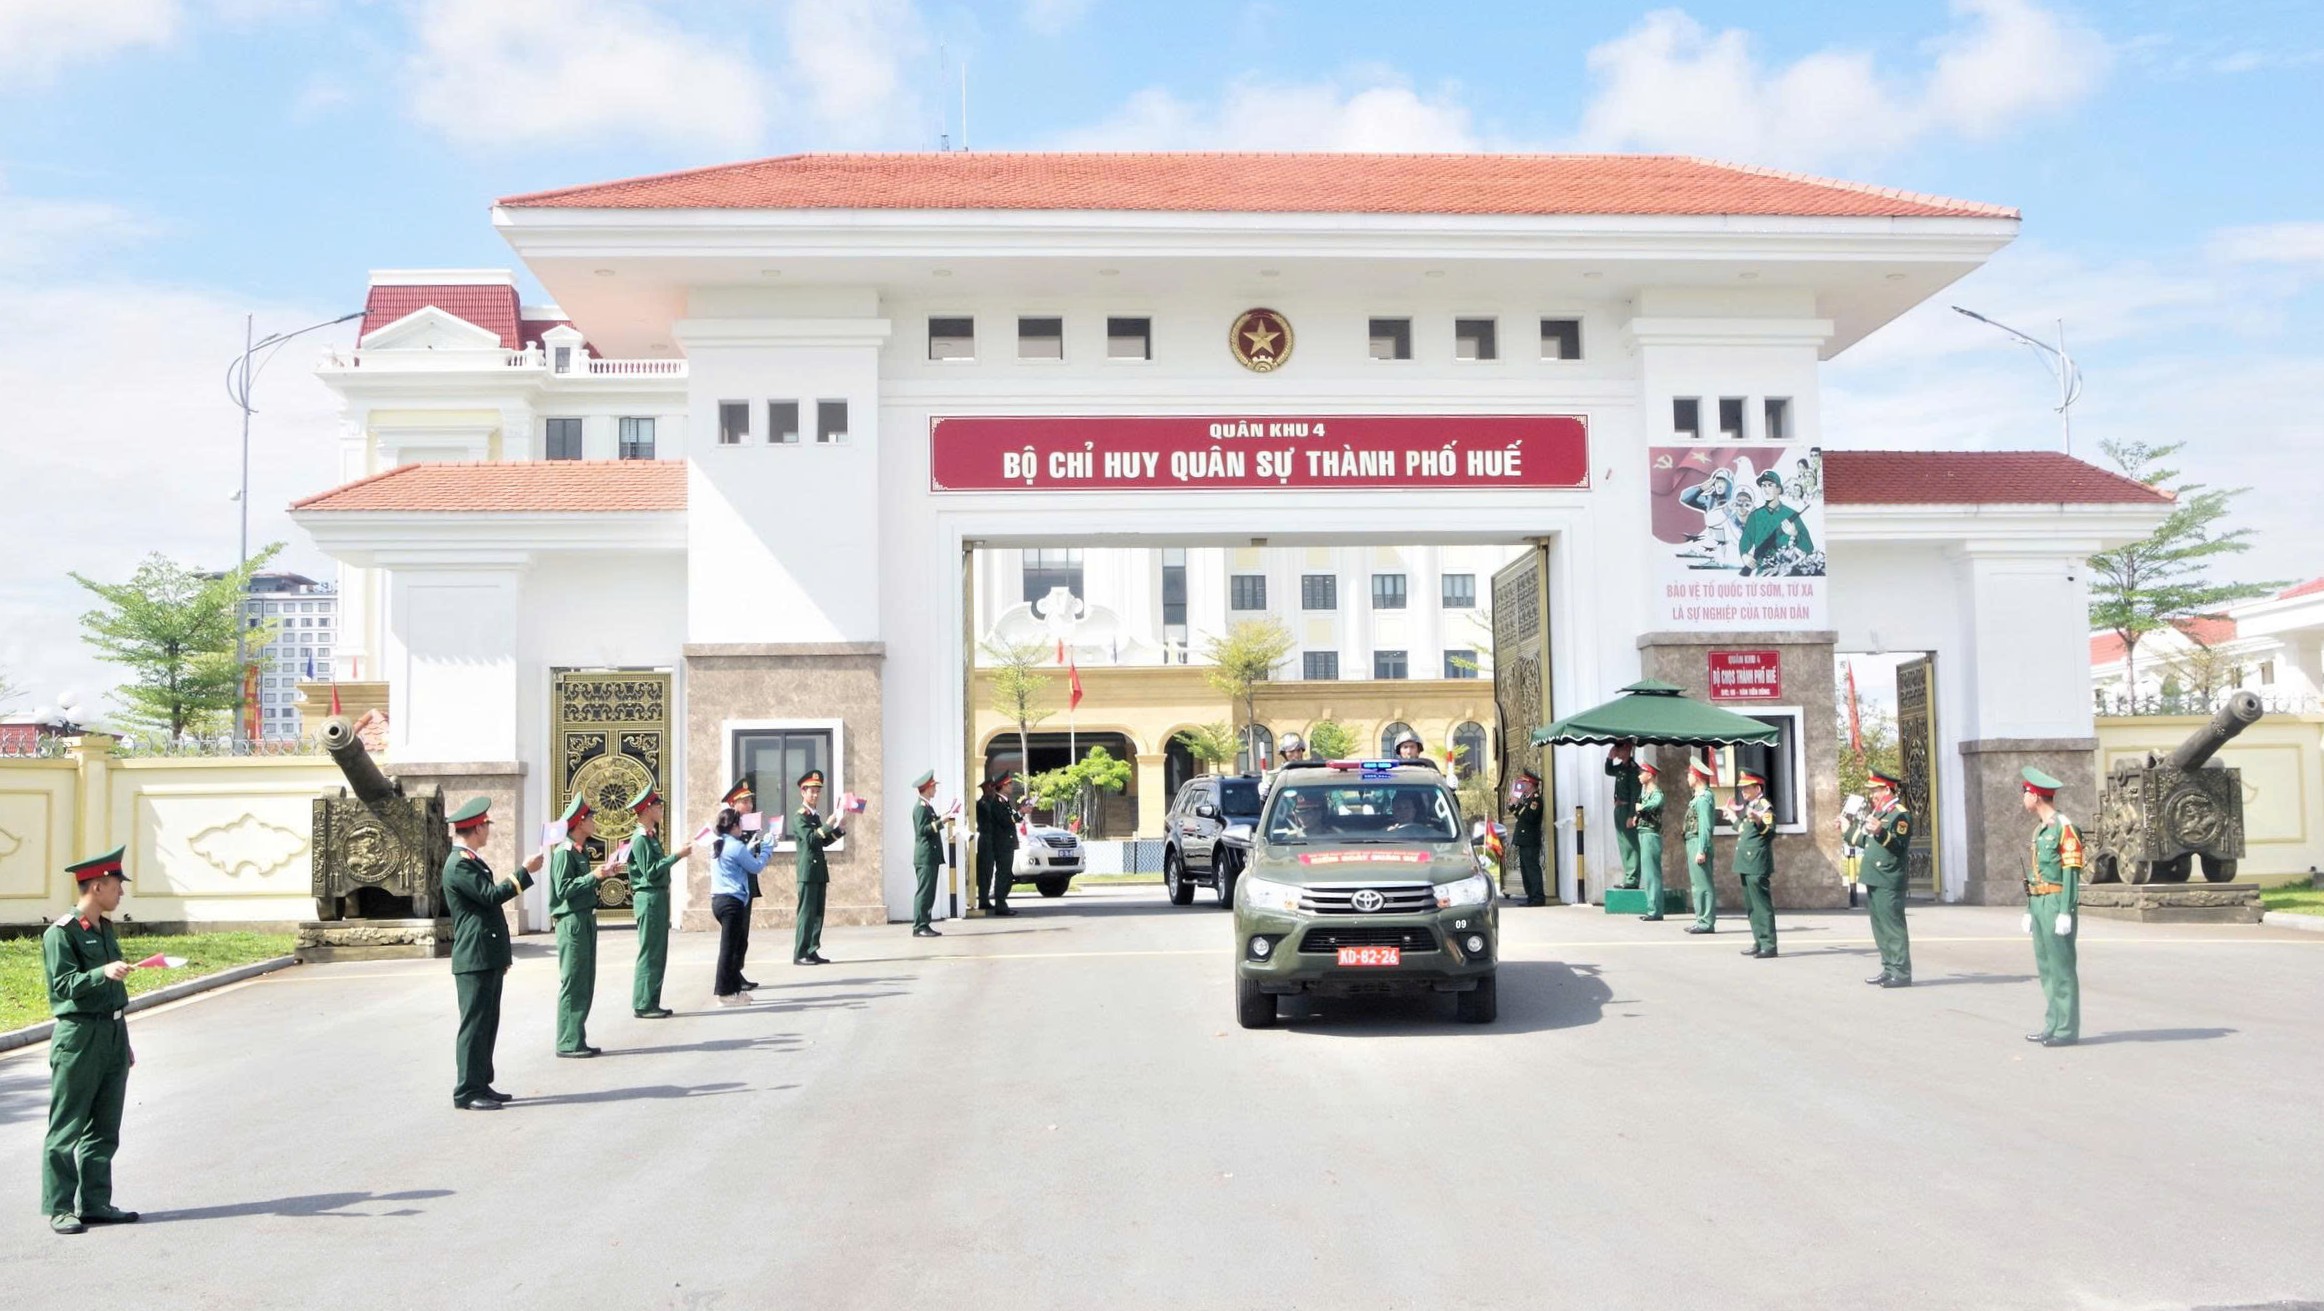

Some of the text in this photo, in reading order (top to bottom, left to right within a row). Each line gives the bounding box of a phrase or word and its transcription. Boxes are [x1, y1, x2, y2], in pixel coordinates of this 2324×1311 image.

[1210, 420, 1325, 438] QUÂN KHU 4
[1004, 440, 1523, 485] BỘ CHỈ HUY QUÂN SỰ THÀNH PHỐ HUẾ
[1666, 580, 1686, 598] BẢO
[1689, 581, 1700, 600] VỆ
[1703, 580, 1714, 598] TỔ
[1717, 580, 1743, 598] QUỐC
[1745, 582, 1758, 597] TỪ
[1787, 582, 1799, 597] TỪ
[1801, 583, 1814, 597] XA
[1672, 603, 1810, 623] LÀ SỰ NGHIỆP CỦA TOÀN DÂN
[1455, 919, 1467, 929] 09
[1340, 949, 1398, 964] KD-82-26
